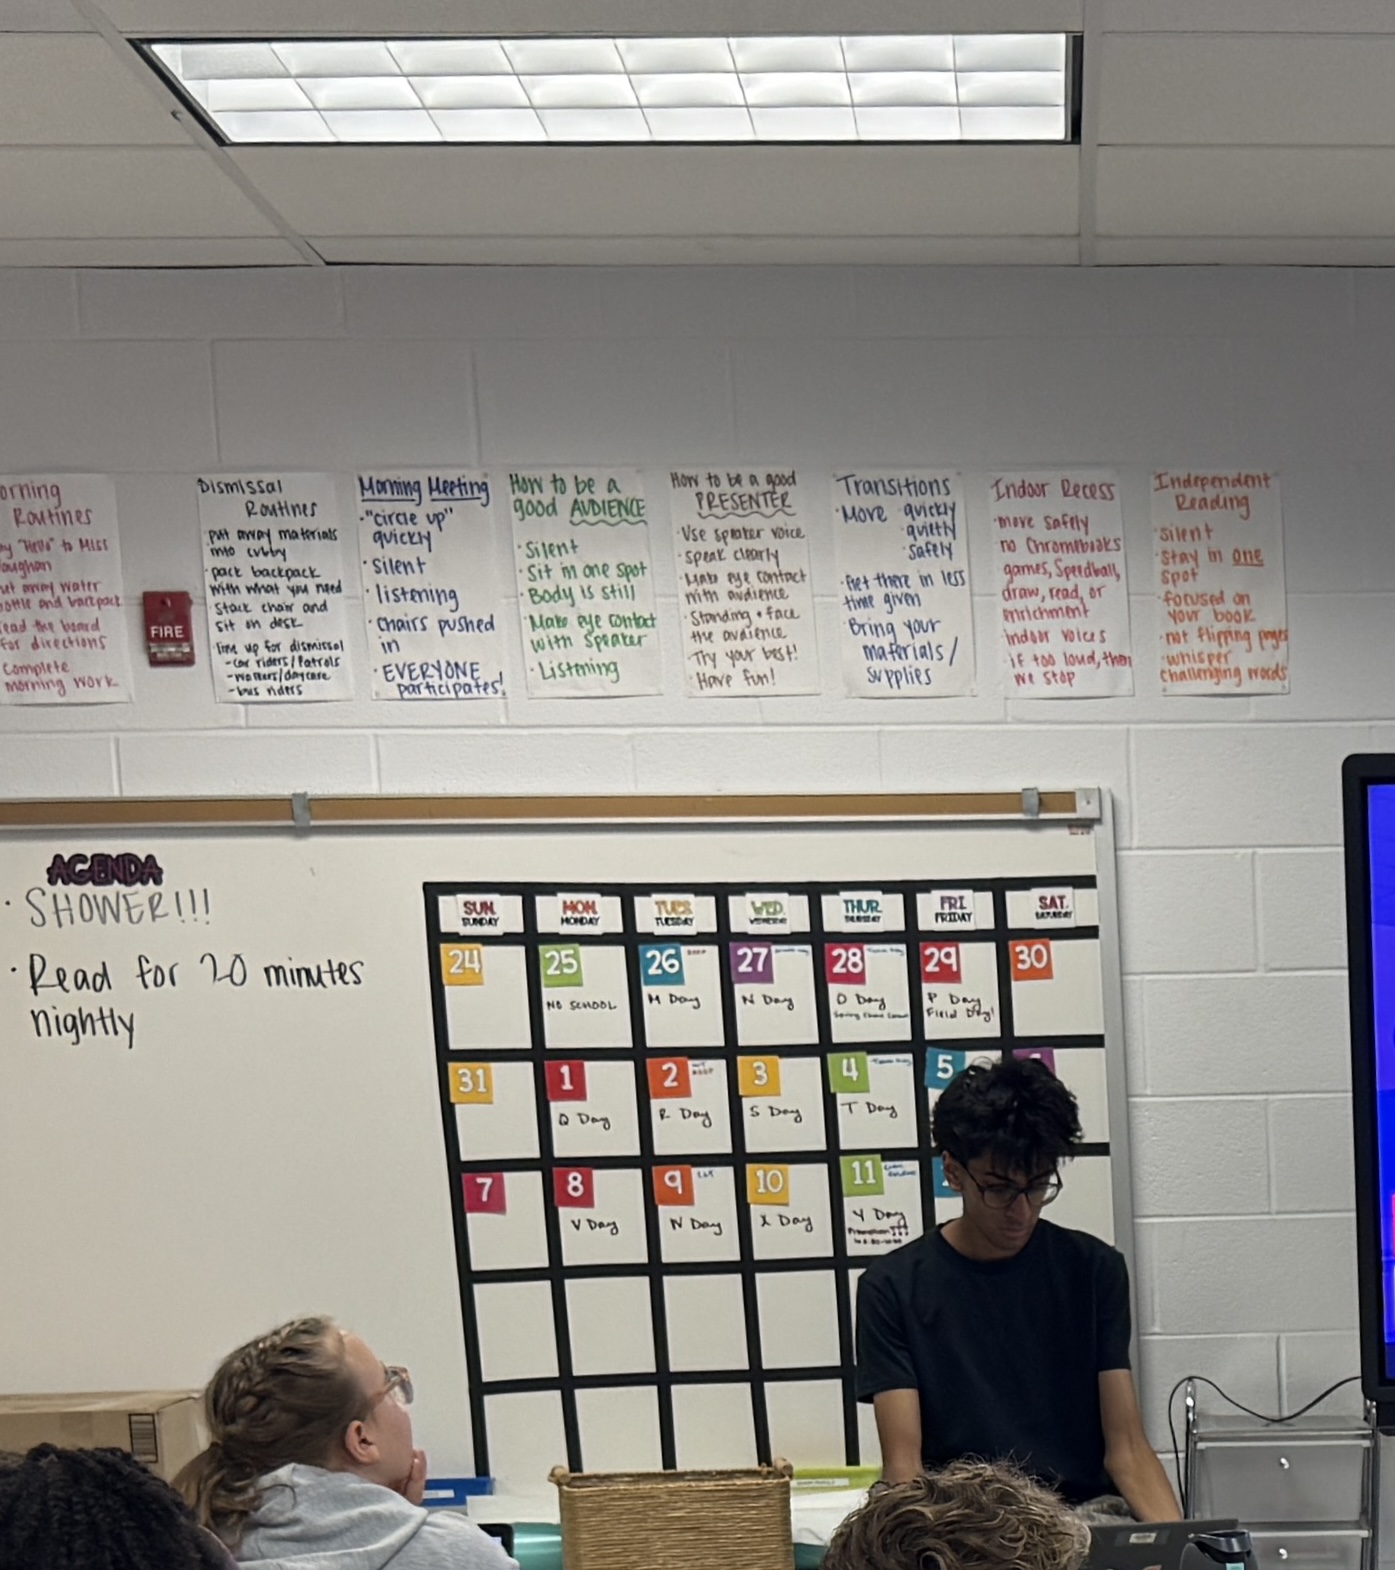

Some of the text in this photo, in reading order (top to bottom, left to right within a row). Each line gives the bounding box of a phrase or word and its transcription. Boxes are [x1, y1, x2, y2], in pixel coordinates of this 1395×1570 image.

[198, 478, 282, 494] Dismissal
[359, 476, 489, 506] Morning Meeting
[510, 473, 620, 495] How to be a
[671, 471, 797, 491] How to be a good
[836, 474, 950, 497] Transitions
[991, 478, 1115, 502] Indoor Recess
[1154, 472, 1272, 492] Independent
[245, 501, 317, 517] Routines
[514, 498, 646, 521] good AUDIENCE
[695, 491, 792, 512] PRESENTER
[1175, 493, 1250, 520] Reading
[13, 508, 92, 527] Routines
[373, 530, 432, 552] quickly
[372, 557, 426, 575] silent
[376, 583, 459, 612] listening
[151, 625, 184, 638] FIRE
[377, 614, 495, 637] chairs pushed
[380, 636, 400, 654] in
[383, 660, 480, 682] EVERYONE
[538, 658, 620, 684] Listening
[397, 671, 506, 698] participates!
[46, 853, 163, 886] AGENDA
[26, 887, 211, 928] SHOWER!!!
[1038, 896, 1069, 911] SAT.
[461, 917, 499, 927] SUNDAY
[561, 917, 600, 926] MONDAY
[655, 917, 694, 926] TUESDAY
[934, 912, 972, 924] FRIDAY
[449, 951, 481, 974] 24
[544, 950, 578, 975] 25
[646, 950, 680, 974] 26
[737, 947, 769, 973] 27
[832, 948, 864, 974] 28
[924, 947, 959, 973] 29
[1016, 944, 1048, 970] 30
[30, 953, 364, 995] Read for 20 minutes
[547, 1000, 617, 1011] NO SCHOOL
[926, 1007, 957, 1019] Field
[31, 1006, 134, 1048] nightly
[560, 1065, 573, 1090] 1
[662, 1063, 678, 1088] 2
[752, 1062, 768, 1086] 3
[841, 1058, 859, 1082] 4
[936, 1056, 954, 1079] 5
[458, 1069, 487, 1092] 31
[680, 1108, 712, 1128] Day
[750, 1106, 802, 1123] S Day
[840, 1101, 898, 1118] T Day
[577, 1114, 611, 1130] Day
[567, 1172, 584, 1197] 8
[664, 1170, 683, 1195] 9
[756, 1169, 785, 1194] 10
[852, 1161, 877, 1185] 11
[476, 1177, 493, 1202] 7
[586, 1219, 619, 1235] Day
